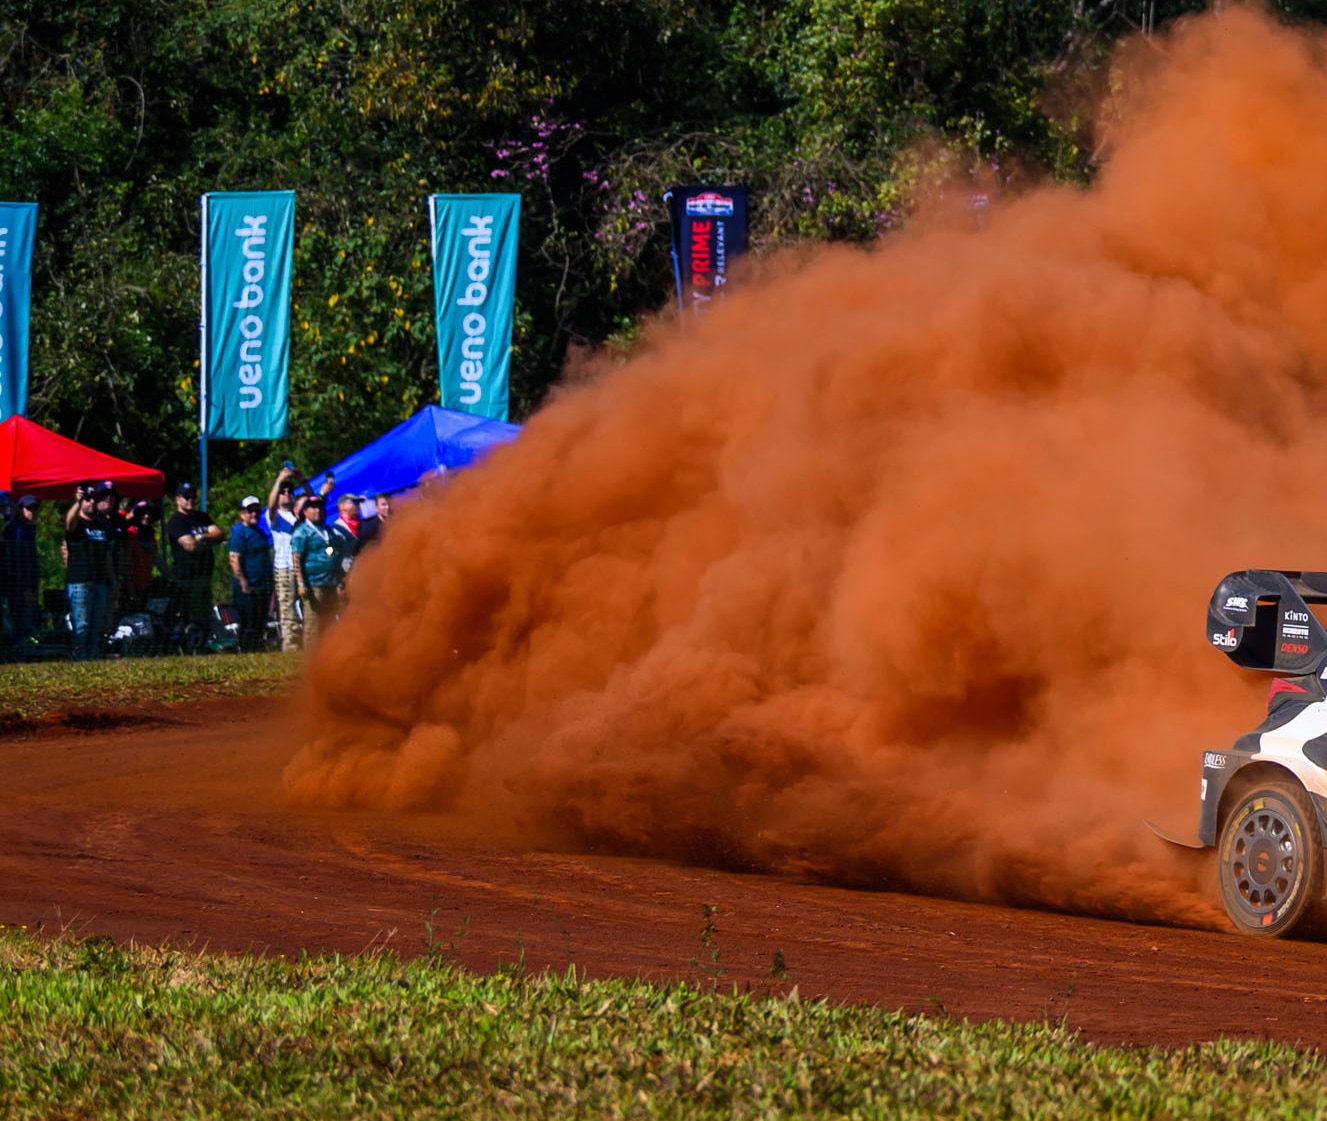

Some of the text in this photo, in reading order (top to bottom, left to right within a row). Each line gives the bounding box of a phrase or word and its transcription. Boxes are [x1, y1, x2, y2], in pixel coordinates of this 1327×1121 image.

[691, 219, 712, 287] PRIME
[233, 214, 268, 409] ueno bank
[456, 215, 493, 405] ueno bank
[1212, 629, 1237, 647] Stilo
[1280, 643, 1309, 655] DENSO
